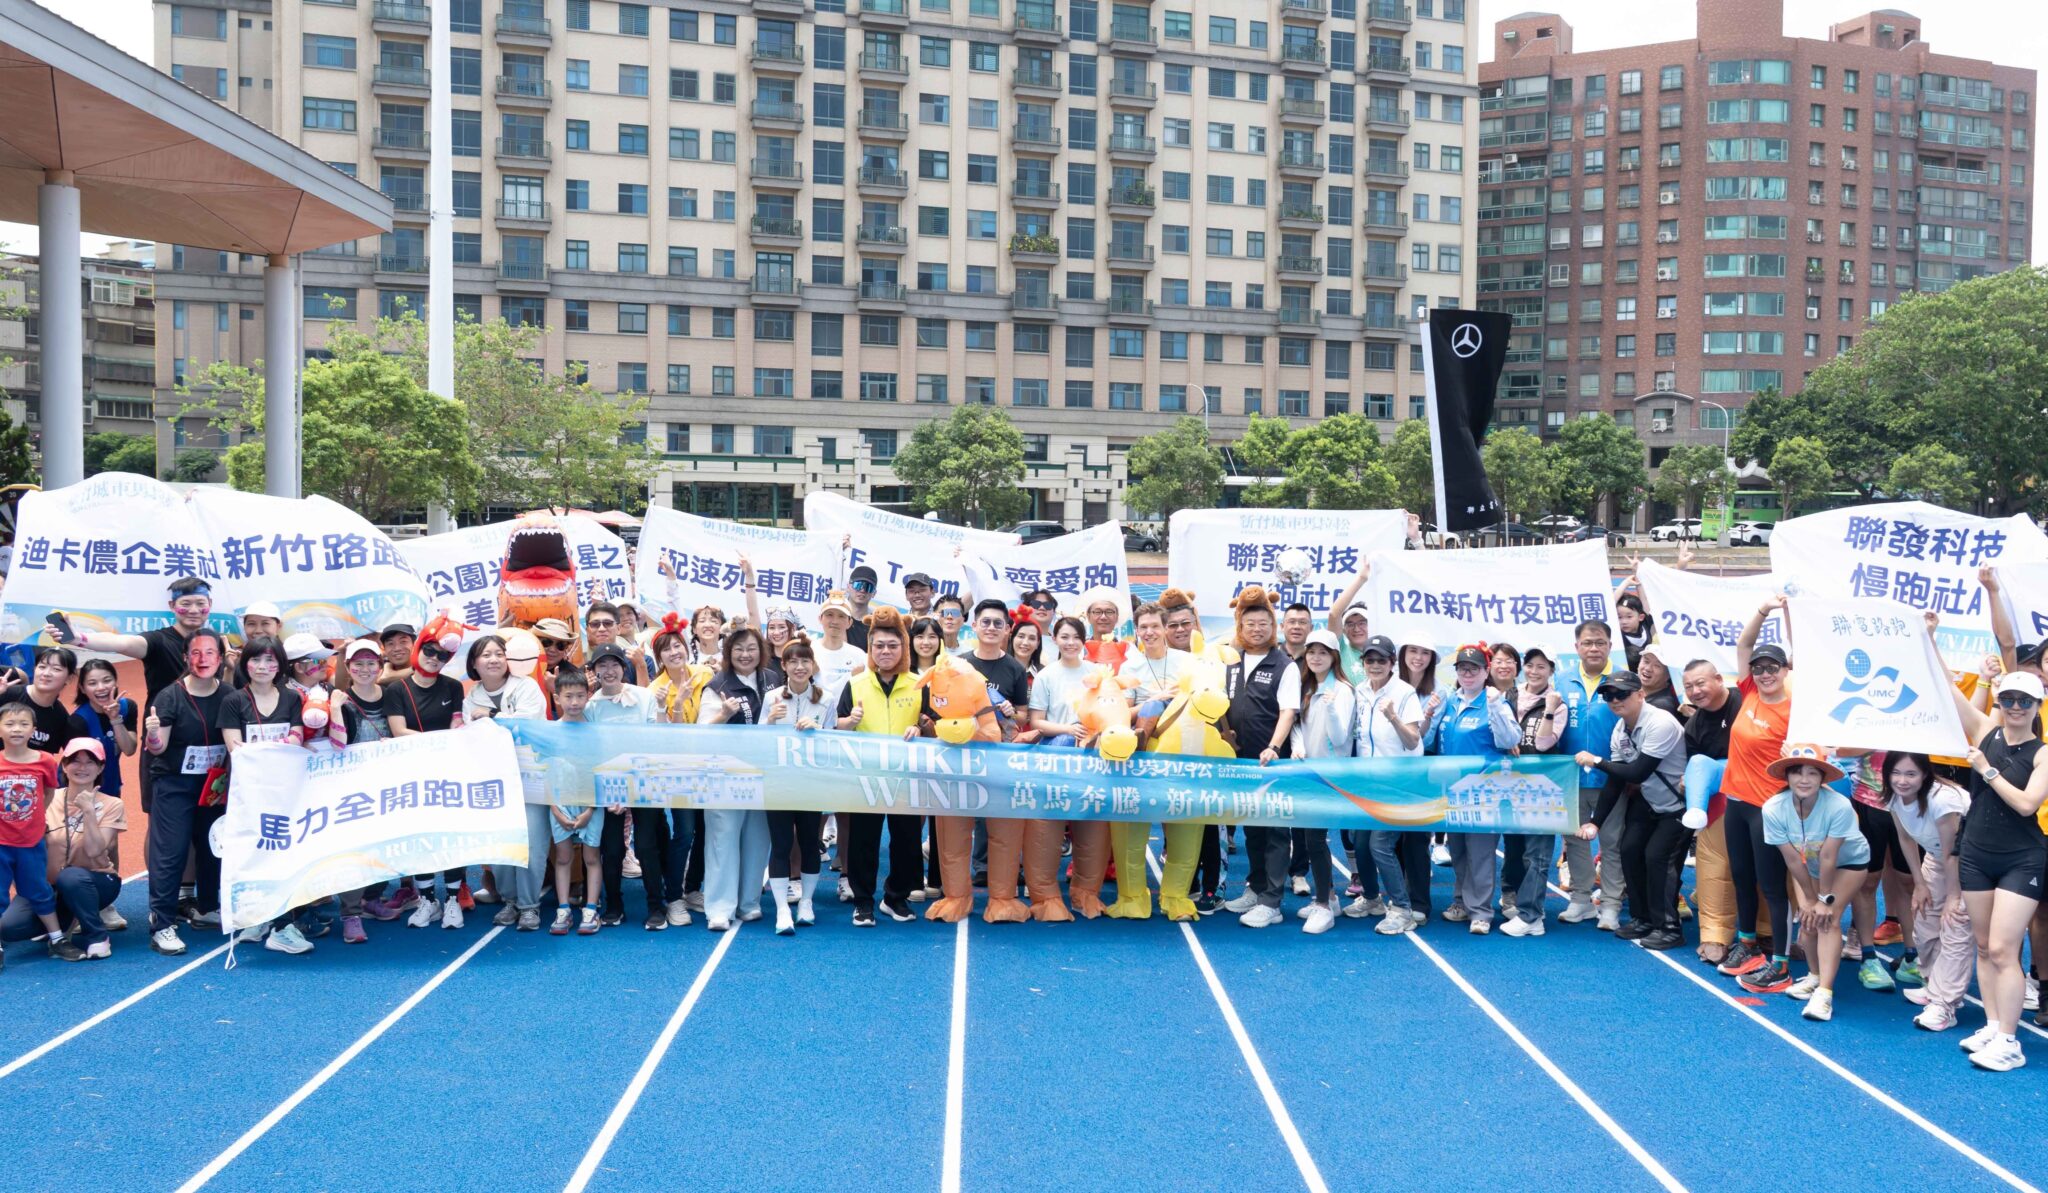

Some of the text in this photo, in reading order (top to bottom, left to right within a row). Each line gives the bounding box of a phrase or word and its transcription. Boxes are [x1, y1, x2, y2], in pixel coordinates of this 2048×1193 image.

[19, 536, 221, 580] 迪卡儂企業社
[222, 533, 416, 580] 新竹路跑
[1844, 515, 2007, 567] 聯發科技
[979, 556, 1118, 596] 齊愛跑
[1849, 562, 1982, 616] 慢跑社A
[1232, 581, 1345, 612] 跑社
[1389, 589, 1607, 625] R2R新竹夜跑團
[1831, 614, 1911, 638] 聯電路跑
[1867, 689, 1896, 698] UMC
[775, 735, 988, 777] RUN LIKE
[859, 775, 989, 810] WIND
[256, 778, 505, 851] 馬力全開跑團
[384, 836, 435, 858] RUN
